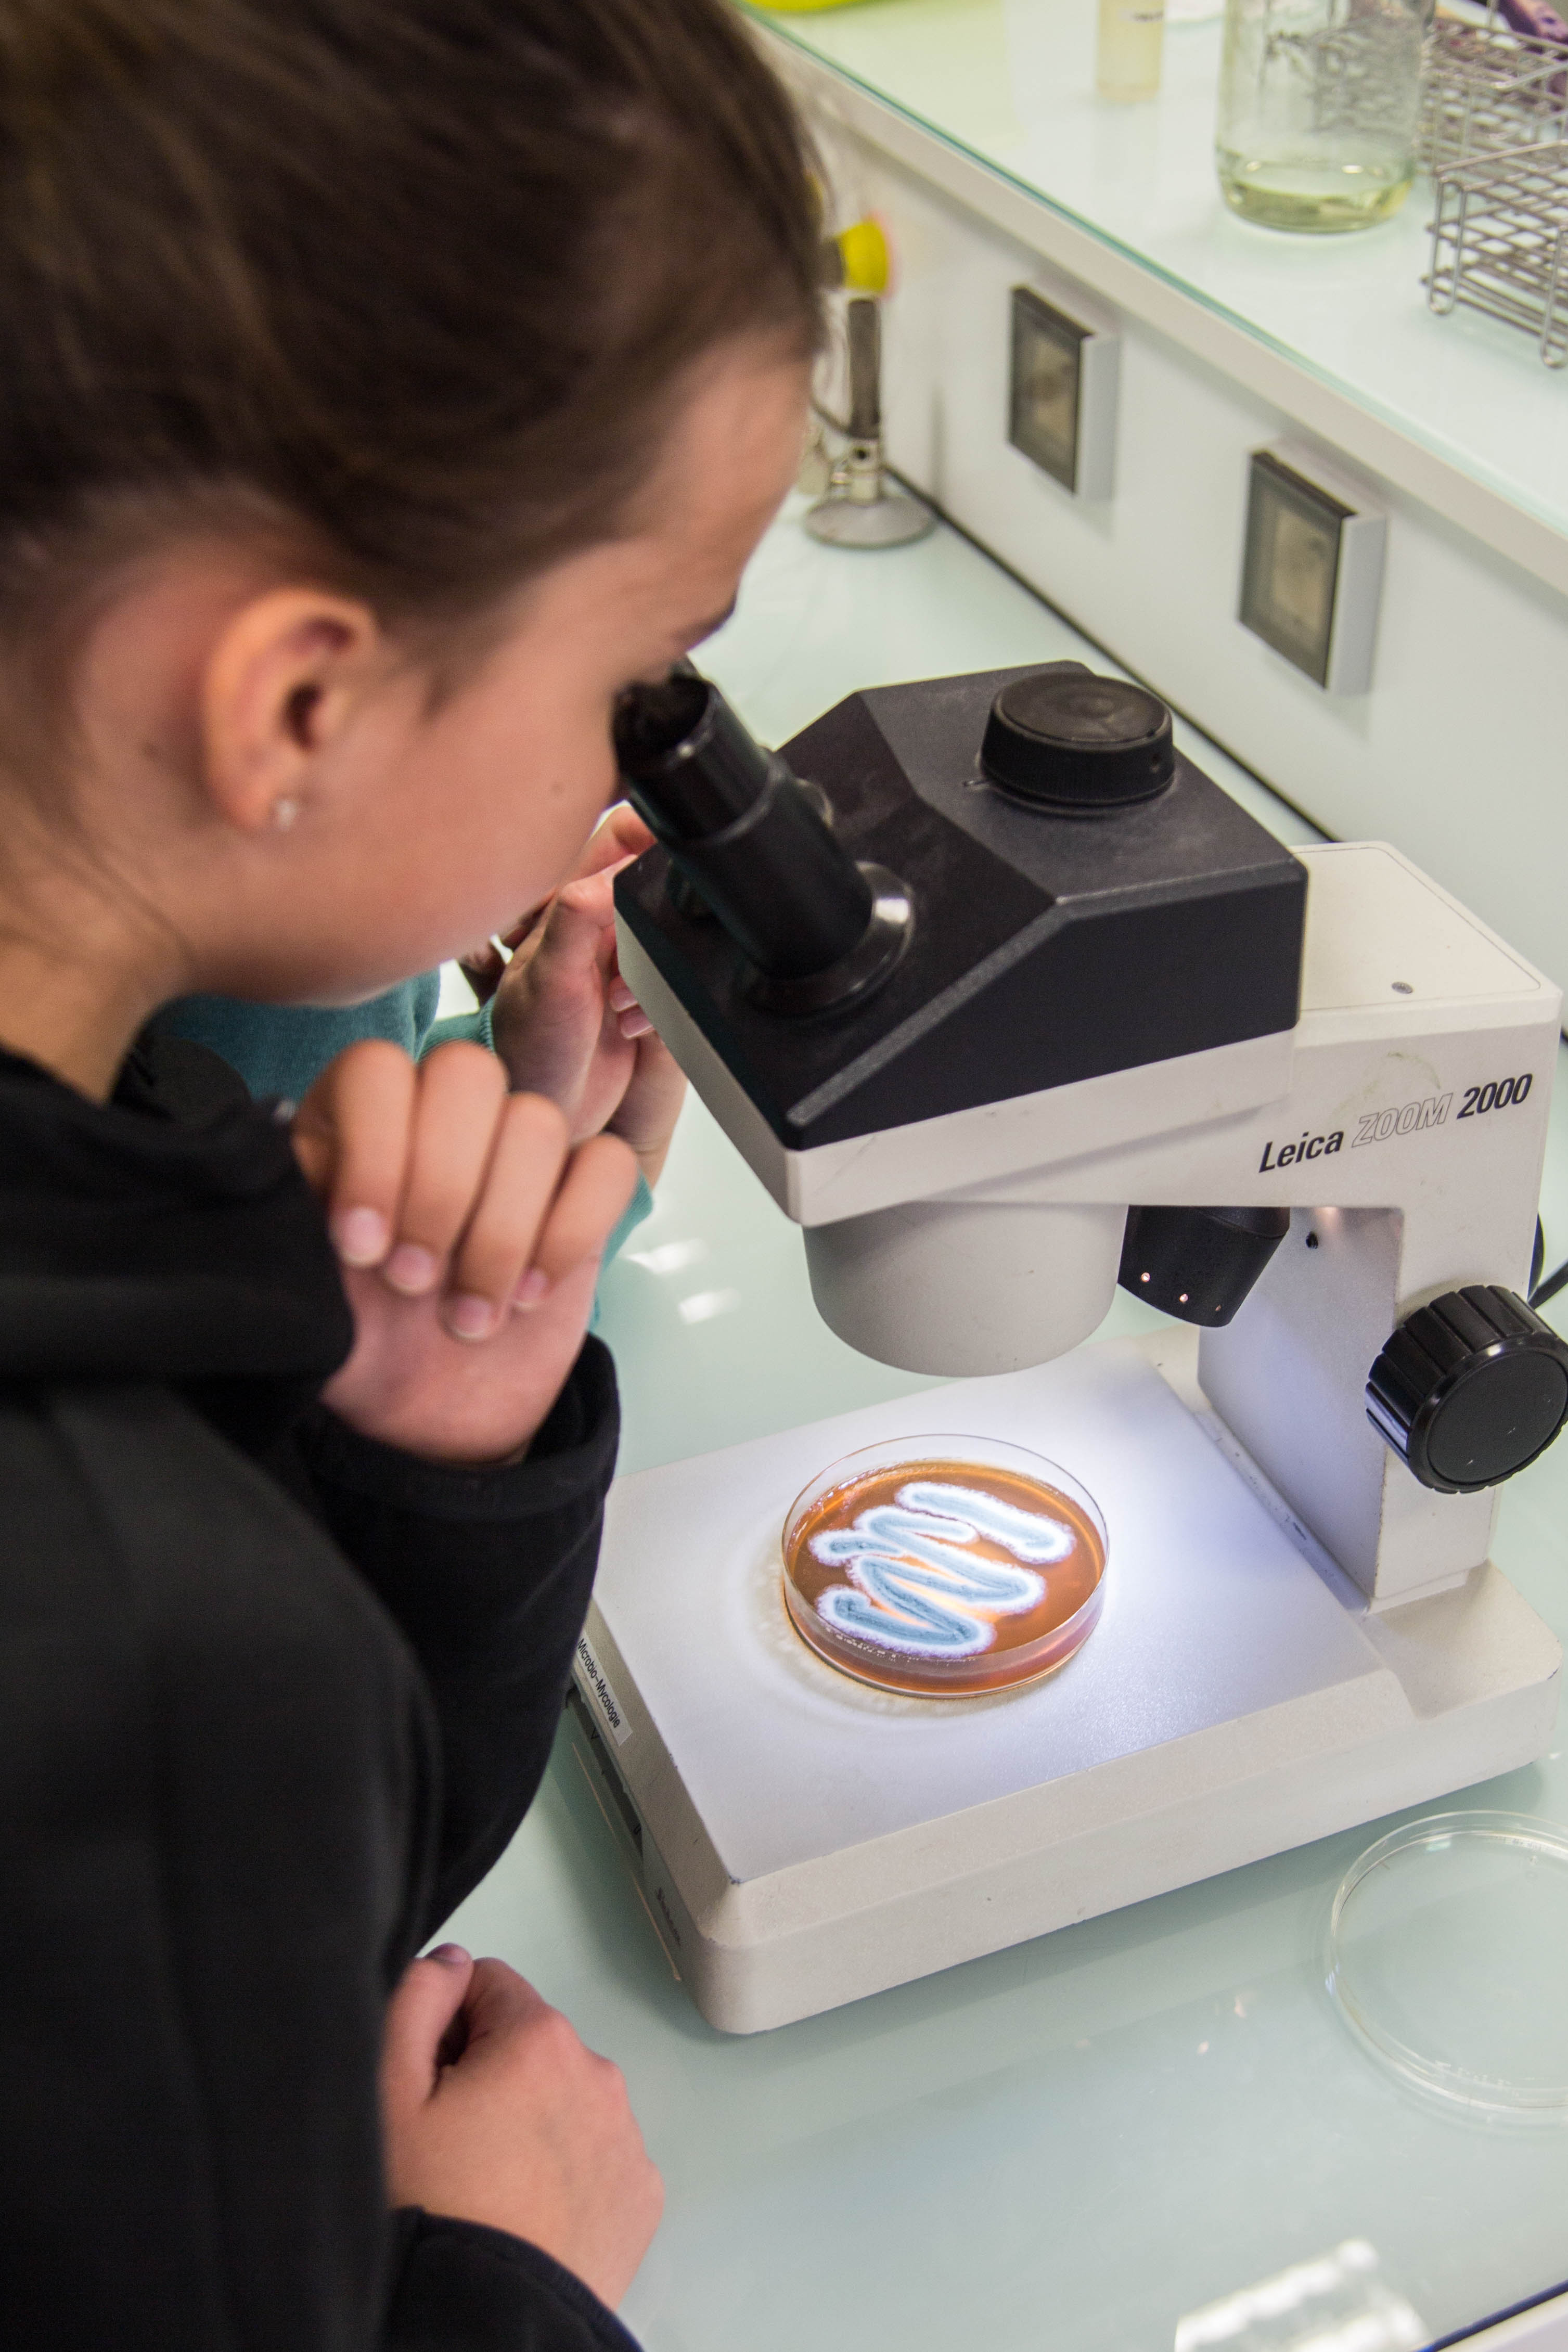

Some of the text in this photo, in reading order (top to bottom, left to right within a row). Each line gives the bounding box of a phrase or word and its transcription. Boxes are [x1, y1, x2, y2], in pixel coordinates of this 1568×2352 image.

[1258, 1073, 1533, 1173] Leica ZOOM 2000
[577, 1638, 621, 1728] Microbio-Mycologie
